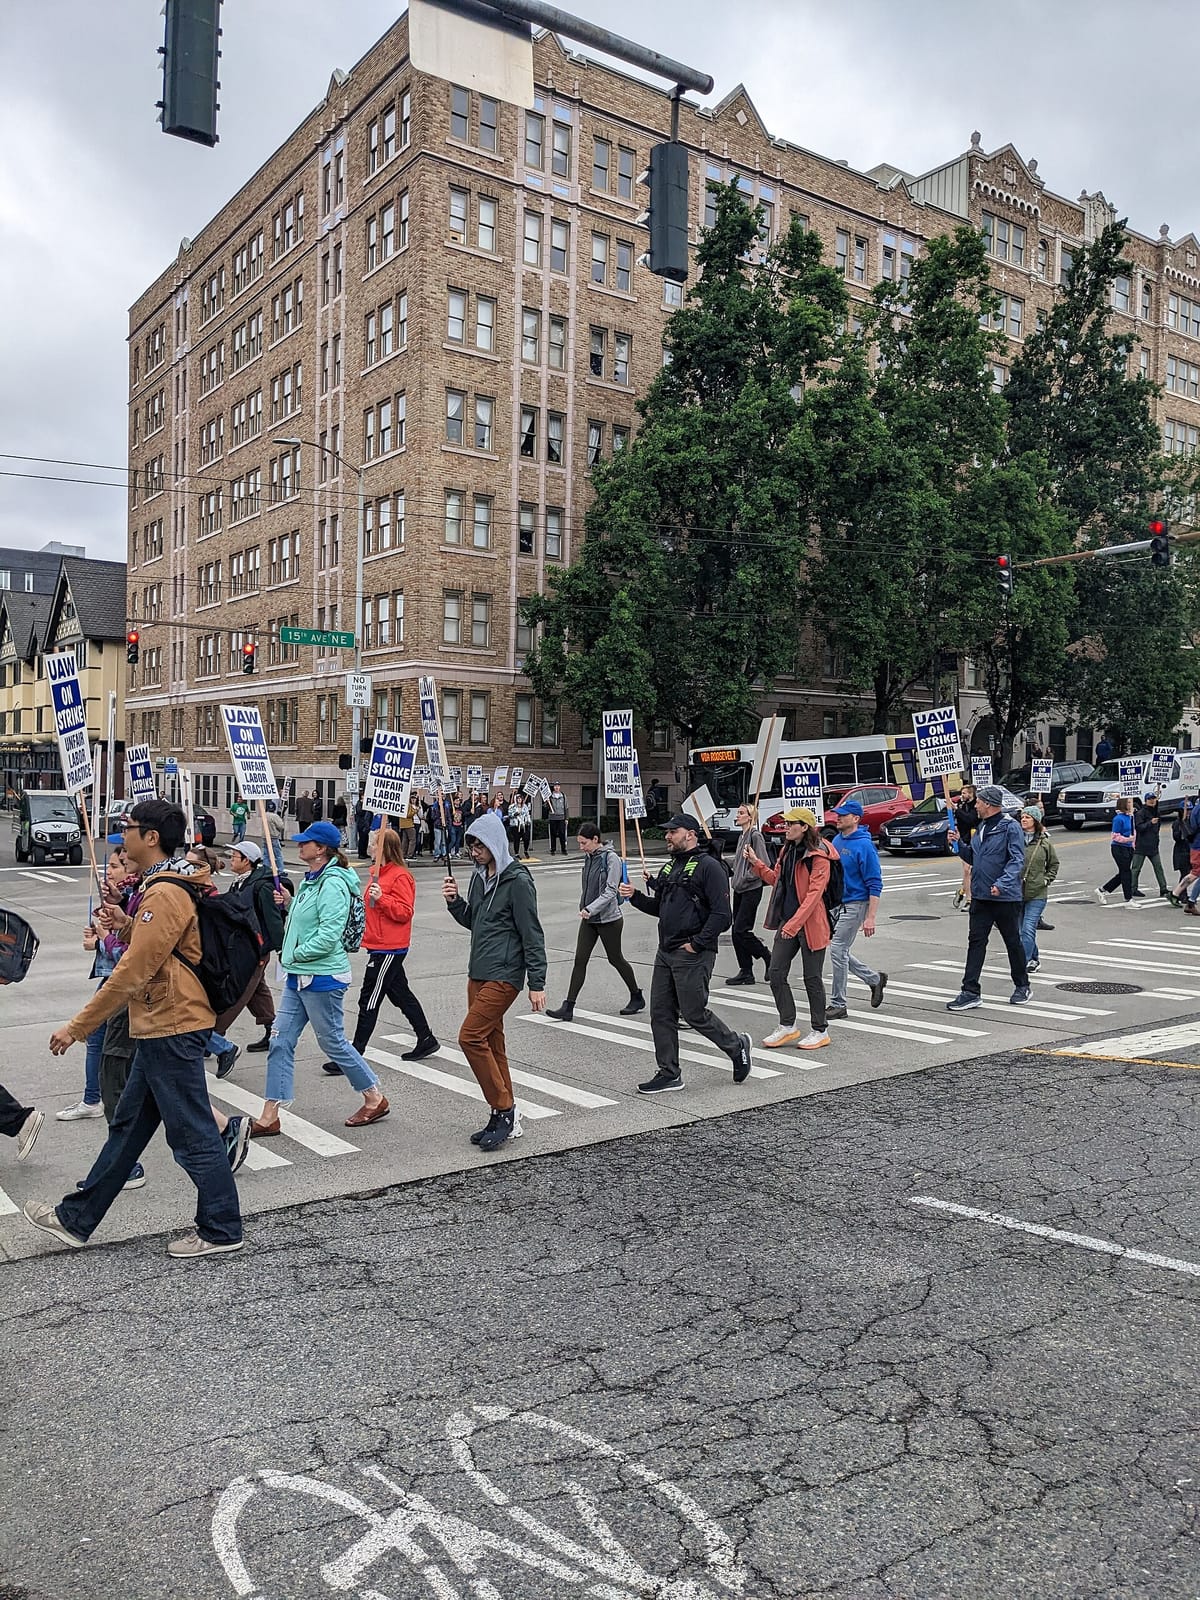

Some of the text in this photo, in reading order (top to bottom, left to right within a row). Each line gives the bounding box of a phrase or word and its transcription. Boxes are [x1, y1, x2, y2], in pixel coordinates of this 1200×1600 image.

[310, 634, 328, 643] AVE
[331, 635, 347, 645] NE
[47, 655, 76, 681] UAW
[353, 676, 365, 684] NO
[61, 684, 73, 706] ON
[57, 704, 85, 731] STRIKE
[225, 708, 258, 725] UAW
[604, 713, 631, 727] UAW
[914, 709, 954, 725] UAW
[240, 728, 254, 742] ON
[612, 730, 623, 745] ON
[928, 725, 944, 736] ON
[64, 731, 85, 752] UNFAIR
[376, 733, 416, 750] UAW
[919, 733, 957, 749] STRIKE
[127, 746, 148, 762] UAW
[233, 742, 266, 757] STRIKE
[606, 745, 631, 759] STRIKE
[710, 750, 736, 762] ROOSEVELT
[925, 745, 955, 758] UNFAIR
[1154, 747, 1175, 755] UAW
[68, 748, 86, 768] LABOR
[384, 751, 401, 765] ON
[928, 754, 955, 766] LABOR
[1120, 759, 1142, 767] UAW
[1152, 760, 1173, 768] STRIKE
[136, 764, 145, 778] ON
[240, 761, 266, 772] UNFAIR
[371, 762, 411, 780] STRIKE
[609, 762, 629, 772] UNFAIR
[783, 762, 819, 773] UAW
[923, 761, 962, 775] PRACTICE
[67, 762, 92, 788] PRACTICE
[244, 773, 268, 783] LABOR
[610, 773, 628, 783] LABOR
[794, 775, 809, 786] ON
[1120, 773, 1142, 781] STRIKE
[133, 777, 154, 792] STRIKE
[242, 784, 276, 795] PRACTICE
[373, 778, 404, 793] UNFAIR
[606, 784, 633, 795] PRACTICE
[785, 785, 820, 797] STRIKE
[373, 788, 400, 802] LABOR
[365, 797, 406, 814] PRACTICE
[626, 805, 646, 816] PRACTICE
[790, 799, 817, 808] UNFAIR
